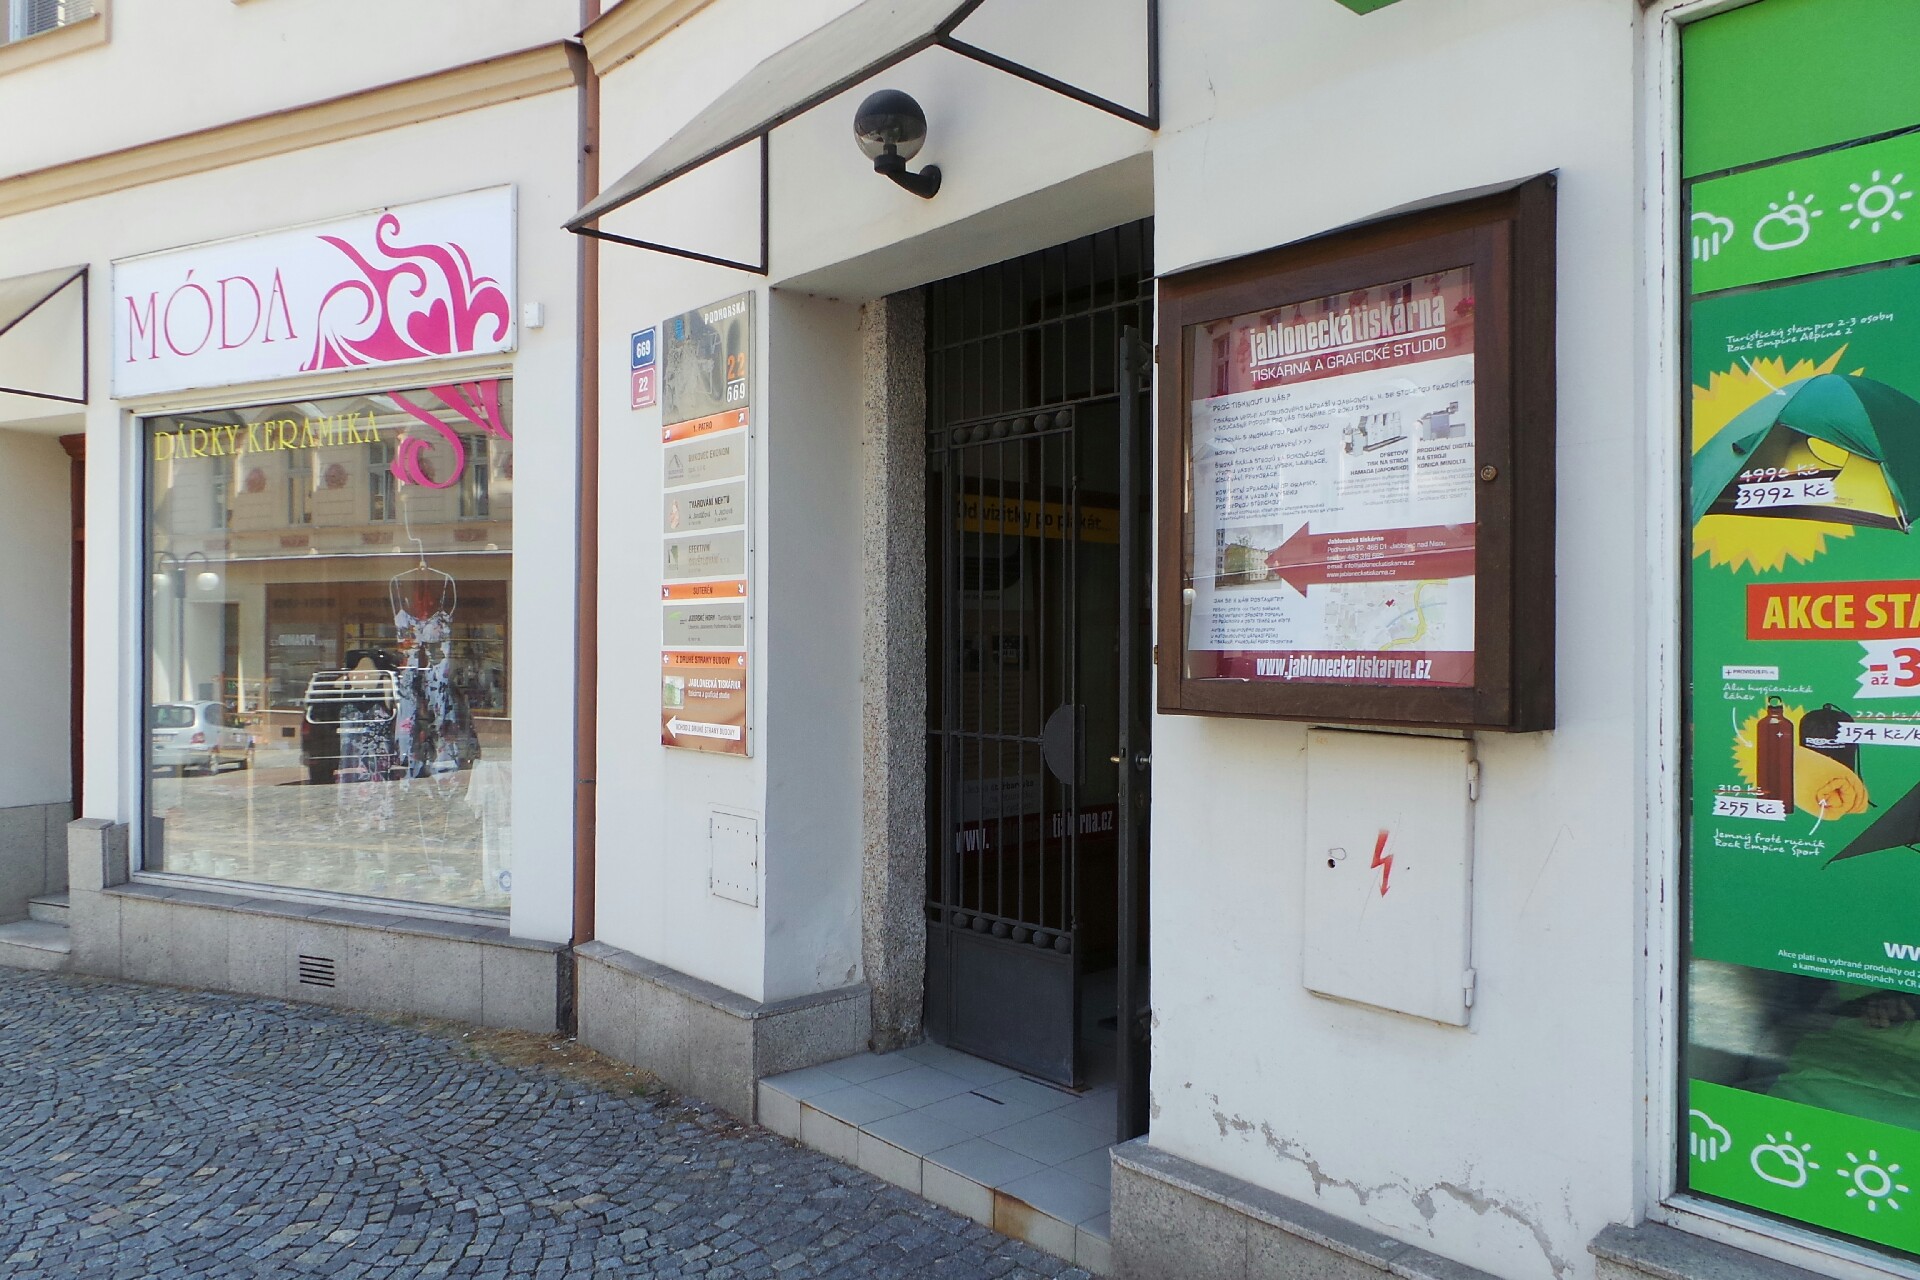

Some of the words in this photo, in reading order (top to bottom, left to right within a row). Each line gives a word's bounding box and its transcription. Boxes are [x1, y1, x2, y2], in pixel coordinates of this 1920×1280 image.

[125, 266, 298, 363] MÓDA
[704, 297, 746, 325] PODHORSKÁ
[1726, 328, 1784, 344] Turistický
[1787, 324, 1813, 335] stan
[1814, 322, 1833, 332] pro
[1838, 317, 1857, 327] 2-3
[1860, 311, 1894, 324] osoby
[636, 340, 651, 358] 669
[1727, 342, 1753, 353] Rock
[1756, 335, 1797, 349] Empire
[1800, 329, 1841, 343] Alpine
[1845, 327, 1853, 335] 2
[727, 352, 746, 380] 22
[1251, 361, 1311, 382] TISKÁRNA
[1314, 358, 1324, 371] A
[1327, 343, 1390, 369] GRAFICKÉ
[1393, 336, 1447, 357] STUDIO
[638, 376, 648, 393] 22
[727, 382, 746, 403] 669
[154, 423, 245, 461] DÁRKY
[247, 410, 382, 453] KERAMIKA
[698, 420, 713, 431] PATRO
[1740, 467, 1790, 483] 4990
[1796, 463, 1820, 476] Kč
[1741, 487, 1794, 506] 3992
[1803, 483, 1830, 497] Kč
[1327, 536, 1359, 545] Jablonecká
[1359, 535, 1384, 543] tiskárna
[1327, 545, 1356, 553] Podhorská
[1389, 542, 1416, 550] Jablonec
[1762, 594, 1855, 629] AKCE
[694, 655, 712, 665] STRANY
[712, 656, 731, 666] BUDOVY
[1256, 655, 1433, 681] www.jabloneckatiskarna.cz
[688, 677, 717, 689] JABLONECKÁ
[717, 677, 742, 690] TISKÁRNA
[1722, 683, 1745, 691] Alu
[1747, 683, 1813, 695] hygienická
[1870, 672, 1889, 686] až
[1723, 692, 1755, 701] láhev
[1845, 727, 1877, 743] 154
[1718, 784, 1741, 797] 319
[1747, 784, 1765, 796] Kč
[1719, 801, 1749, 816] 255
[1756, 802, 1776, 815] Kč
[1713, 828, 1752, 844] Jemný
[1754, 833, 1782, 844] froté
[1784, 838, 1826, 848] ručník
[1715, 838, 1741, 848] Rock
[1744, 842, 1785, 854] Empire
[1791, 845, 1820, 857] Sport
[1777, 949, 1797, 959] Akce
[1797, 952, 1816, 961] platí
[1828, 958, 1862, 969] vybrané
[1863, 962, 1902, 976] produkty
[1903, 969, 1915, 977] od
[1798, 962, 1846, 977] kamenných
[1846, 971, 1895, 984] prodejnách
[1904, 978, 1917, 988] ČR
